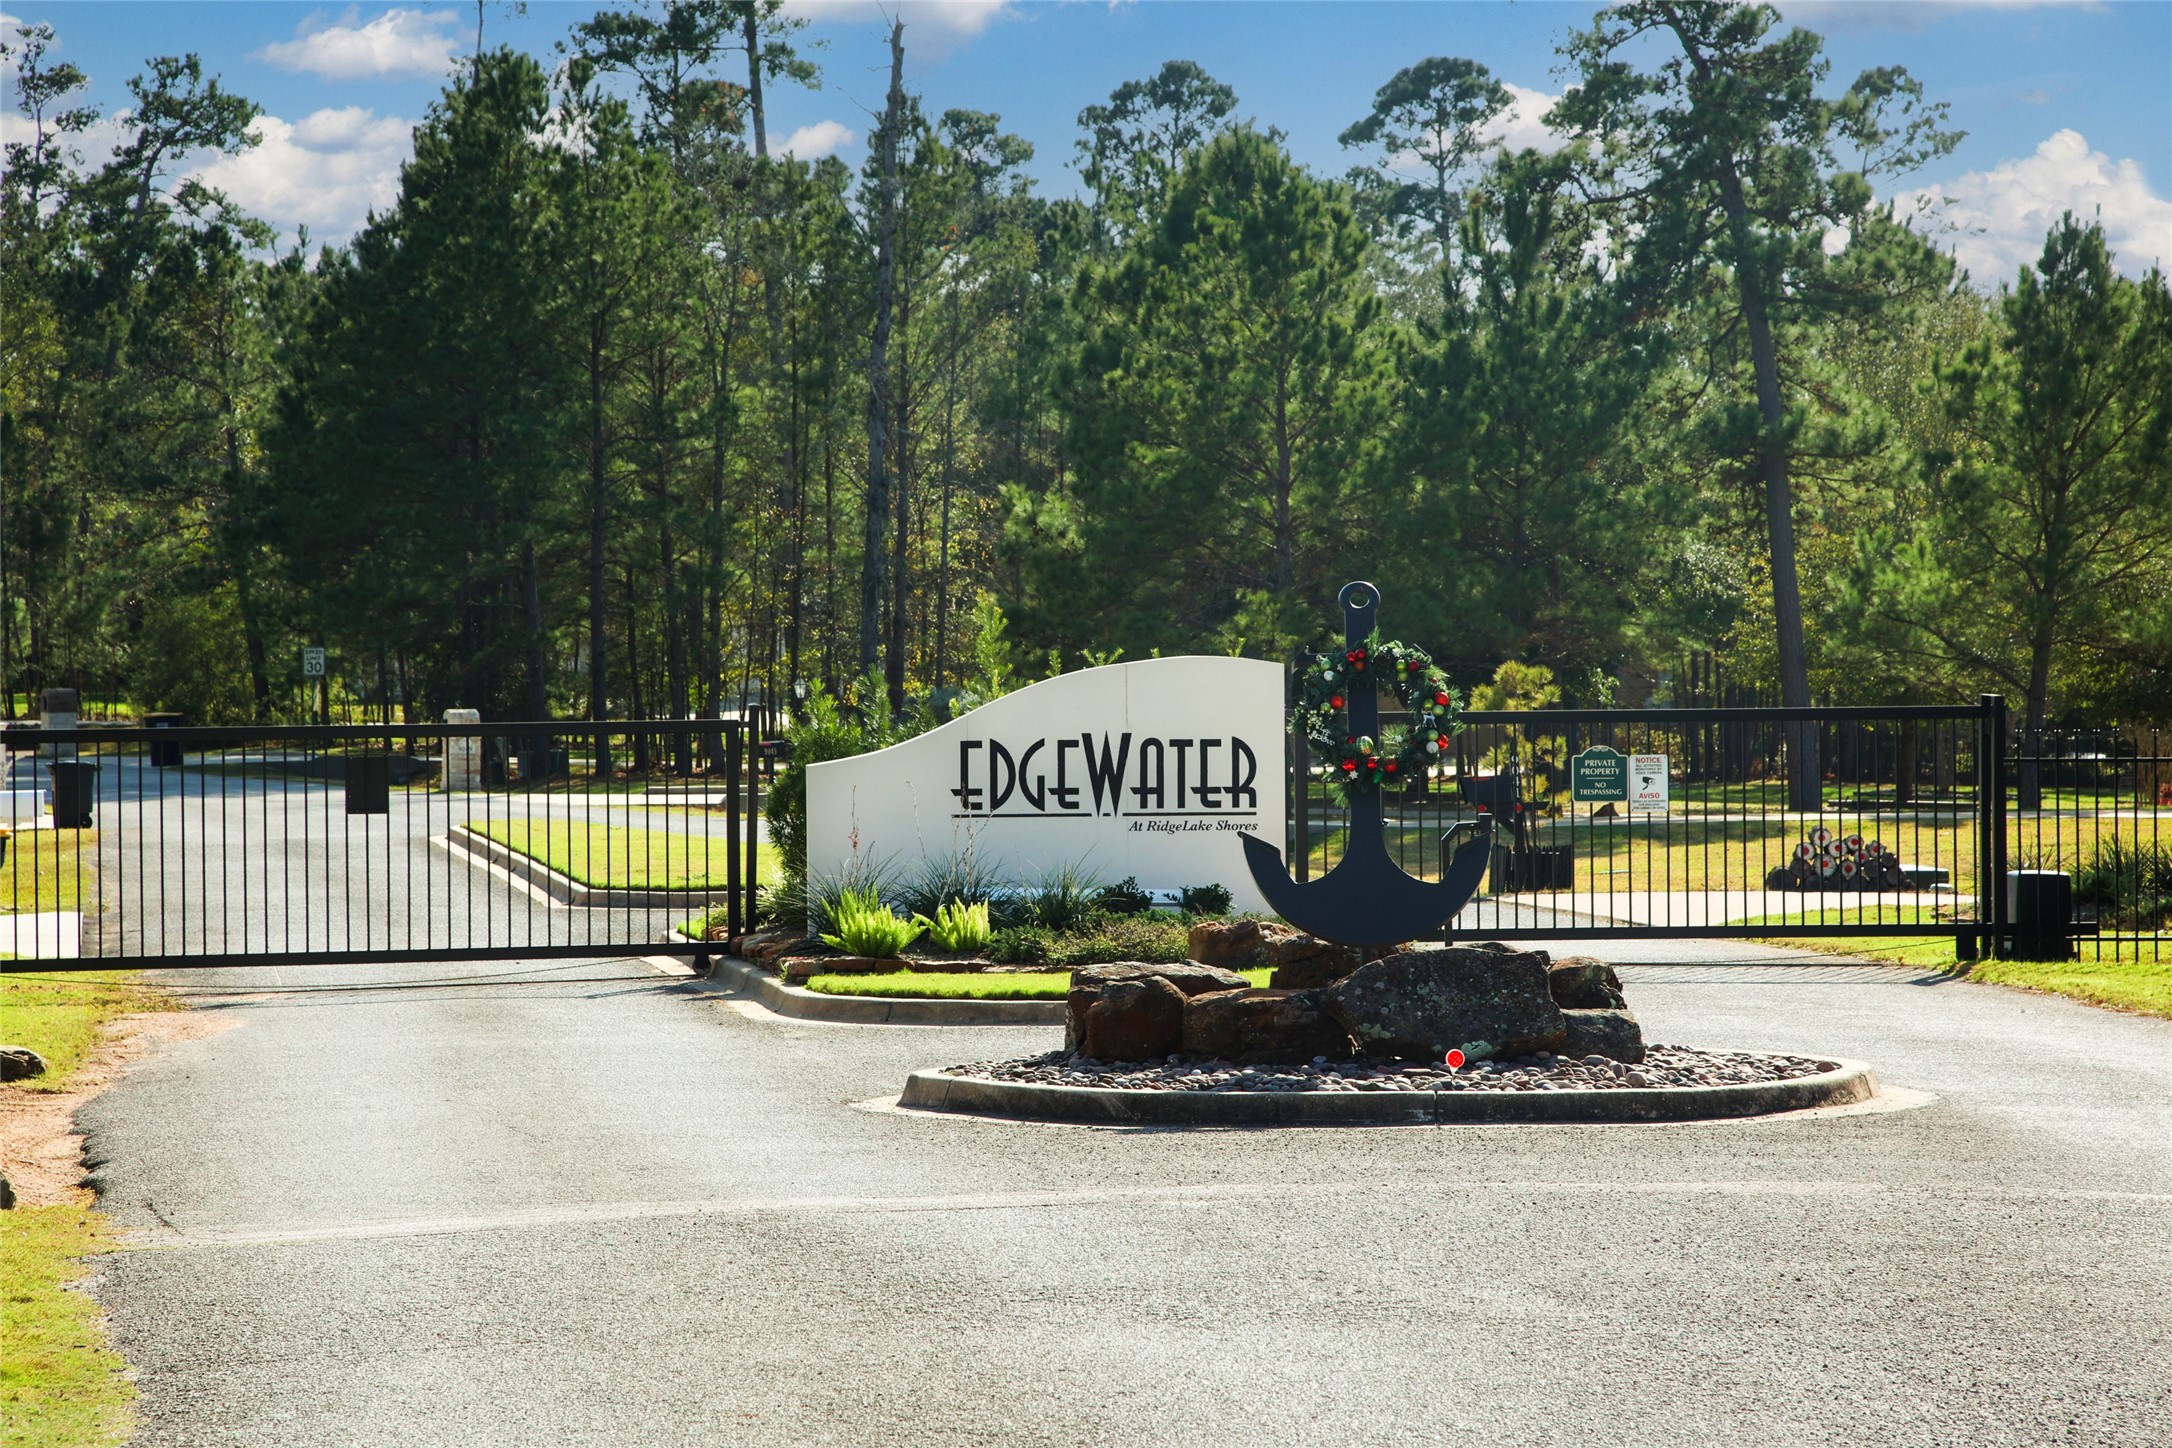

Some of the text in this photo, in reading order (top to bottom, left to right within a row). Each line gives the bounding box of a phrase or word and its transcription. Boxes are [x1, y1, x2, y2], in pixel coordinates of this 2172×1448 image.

[306, 661, 322, 673] 30
[1584, 759, 1616, 767] PRIVATE
[950, 730, 1257, 818] EDGEWATER
[1129, 819, 1258, 835] At RidgeLake Shores
